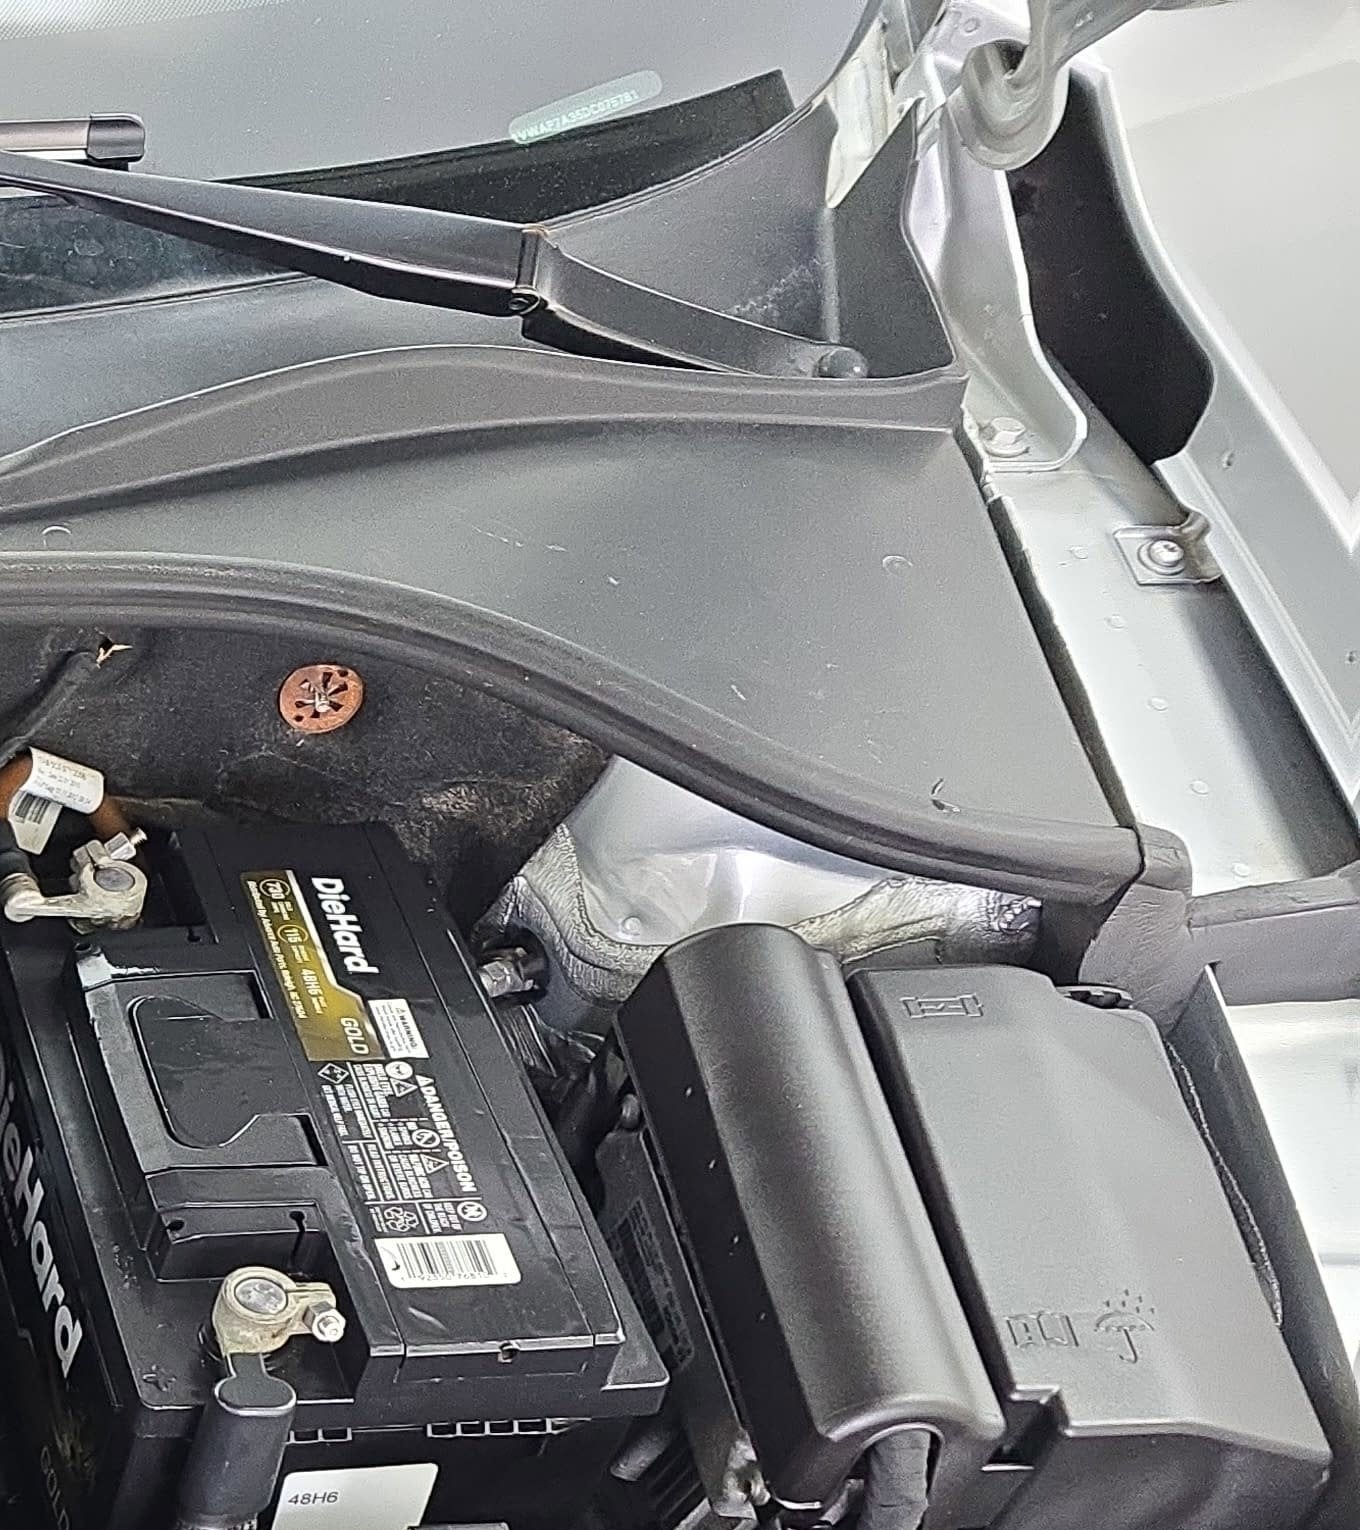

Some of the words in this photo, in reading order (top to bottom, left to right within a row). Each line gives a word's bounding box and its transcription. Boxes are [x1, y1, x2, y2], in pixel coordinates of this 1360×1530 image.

[311, 877, 380, 974] DieHard
[340, 1017, 369, 1055] GOLD
[420, 1087, 477, 1192] DANGER/POISON
[288, 1491, 339, 1505] 48H6
